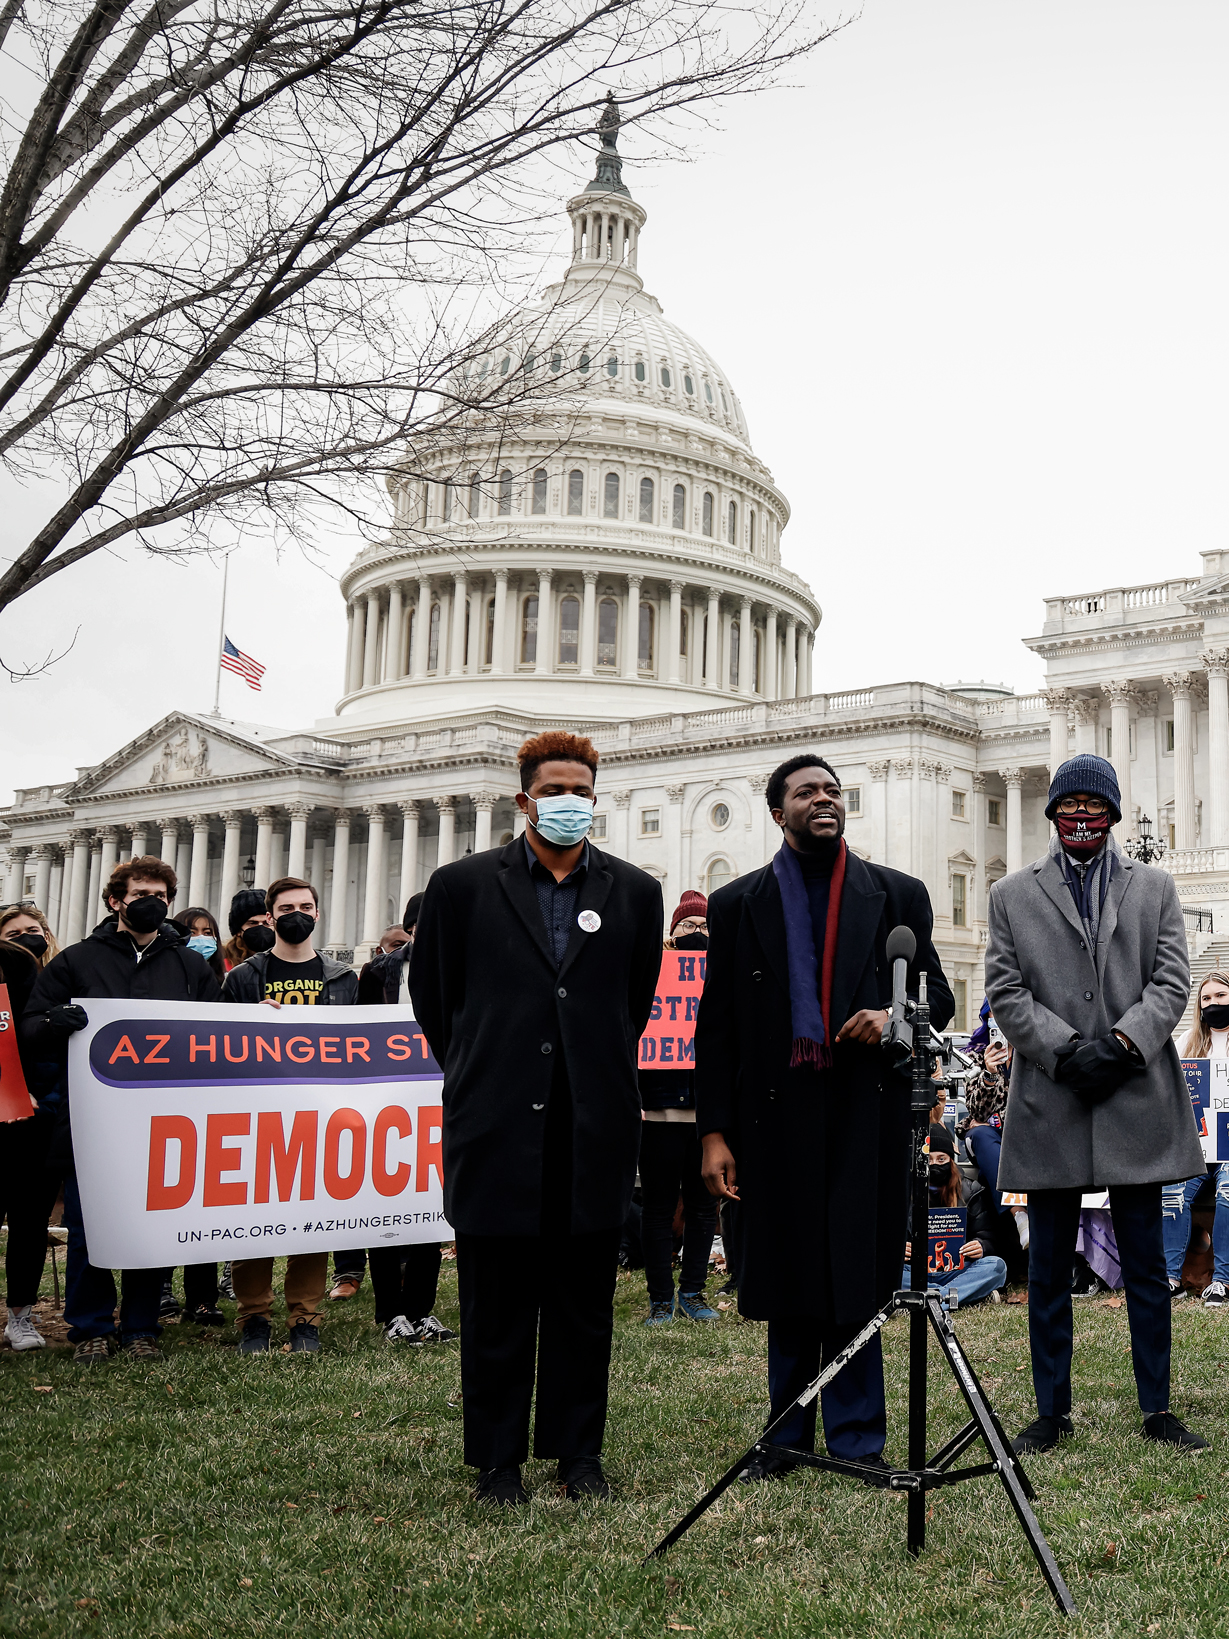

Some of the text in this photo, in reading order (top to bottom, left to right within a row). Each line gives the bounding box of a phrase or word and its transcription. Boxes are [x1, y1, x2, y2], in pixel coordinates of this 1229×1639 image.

[1077, 822, 1087, 830] M
[108, 1034, 171, 1065] AZ
[189, 1034, 371, 1063] HUNGER
[641, 1037, 695, 1061] DEM
[146, 1105, 443, 1212] DEMOCR
[177, 1211, 445, 1243] UN-PAC.ORG #AZHUNGERSTRIK
